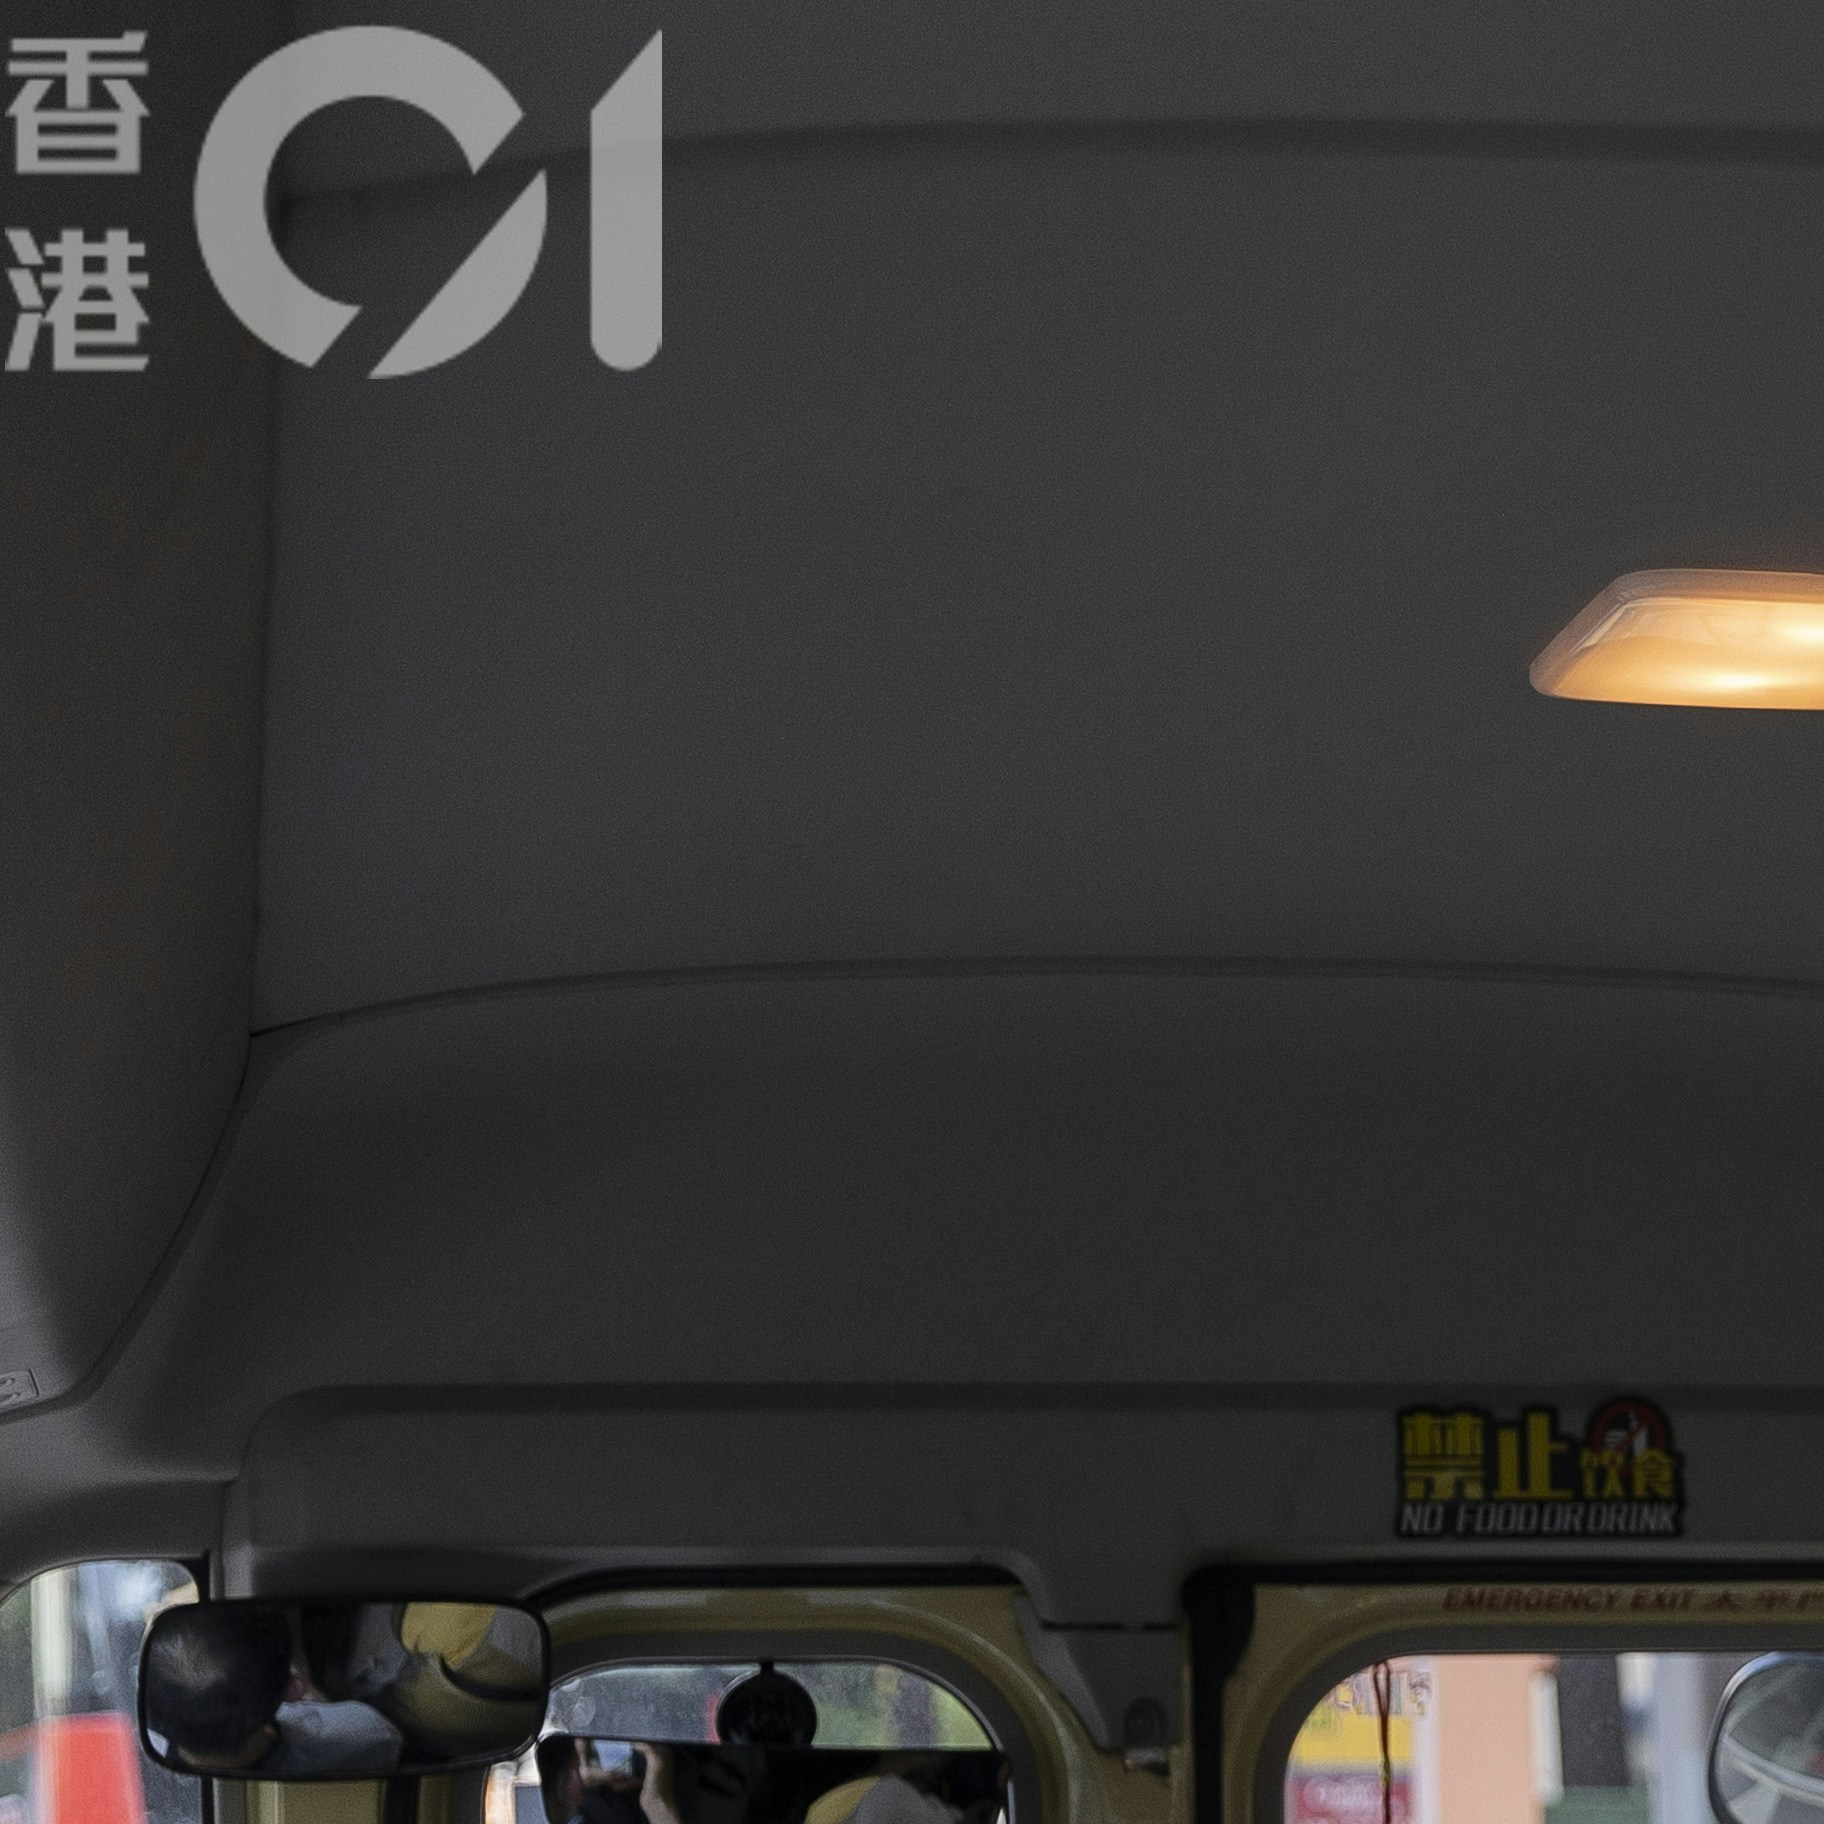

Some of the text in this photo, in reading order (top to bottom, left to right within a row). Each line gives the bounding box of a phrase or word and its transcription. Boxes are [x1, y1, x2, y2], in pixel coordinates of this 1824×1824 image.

[1403, 1411, 1674, 1499] 禁止飲食
[1400, 1502, 1678, 1534] NO FOOD OR DRINK
[1443, 1586, 1623, 1611] EMERGENCY
[1629, 1587, 1696, 1612] EXIT
